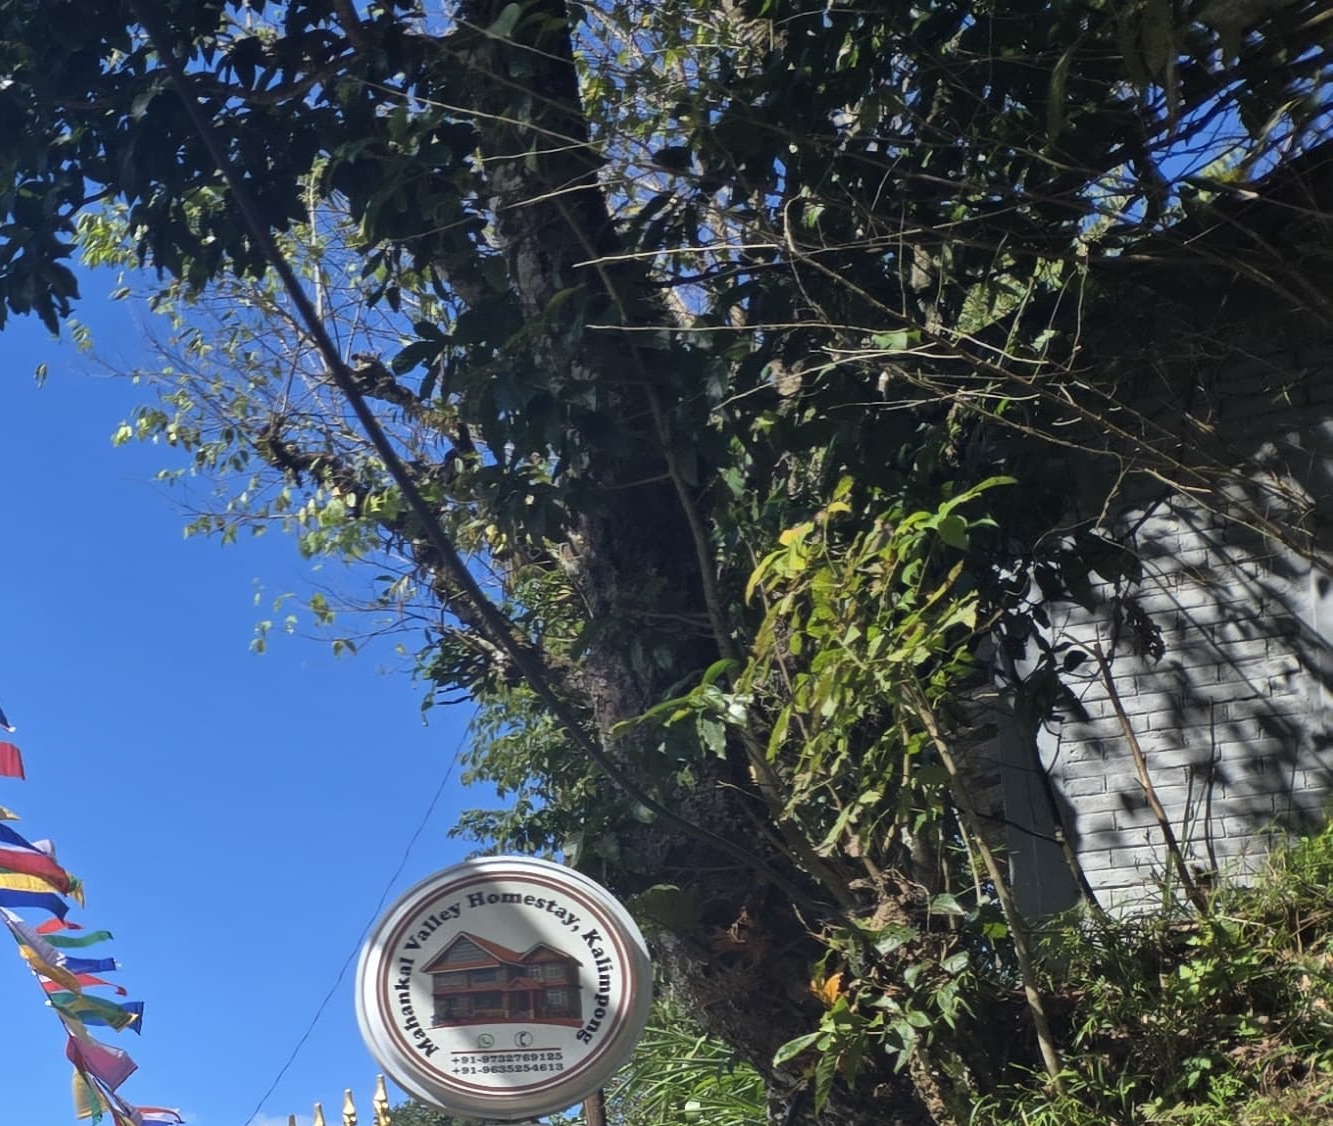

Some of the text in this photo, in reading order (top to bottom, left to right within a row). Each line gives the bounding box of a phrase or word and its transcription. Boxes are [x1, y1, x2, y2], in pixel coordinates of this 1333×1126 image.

[394, 891, 613, 1057] Mahankal Valley Homestay, Kalimpong
